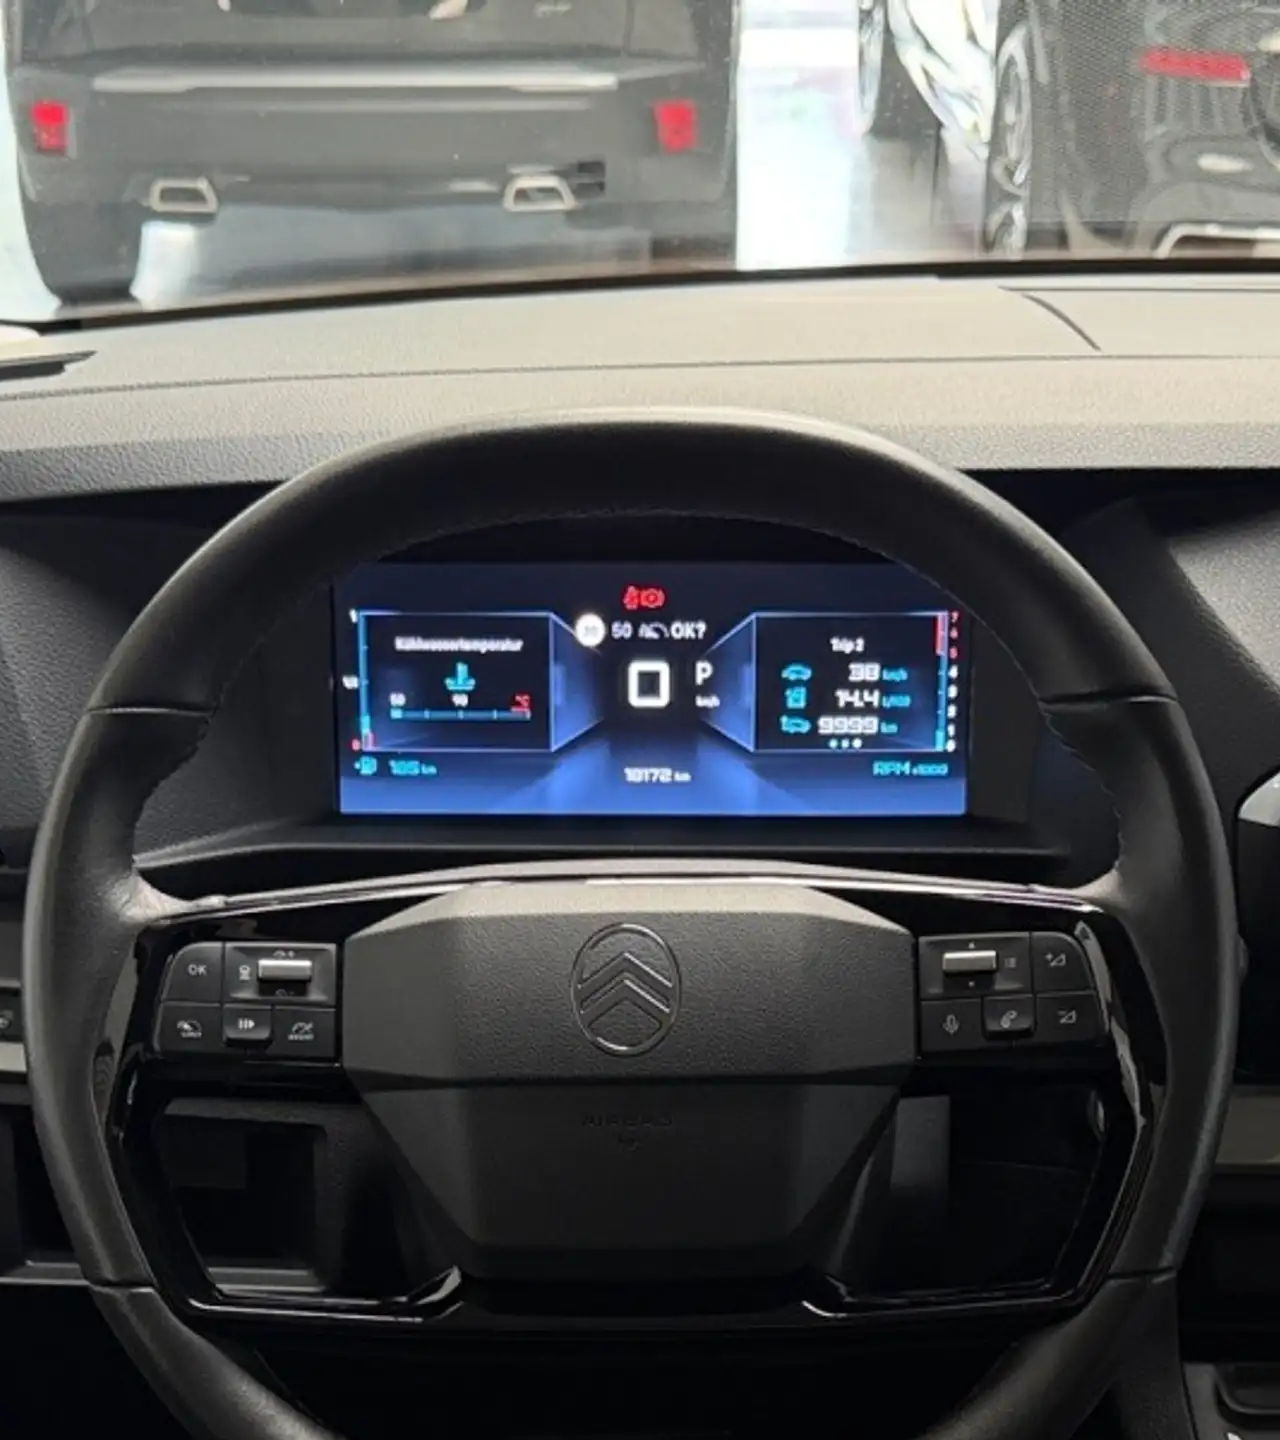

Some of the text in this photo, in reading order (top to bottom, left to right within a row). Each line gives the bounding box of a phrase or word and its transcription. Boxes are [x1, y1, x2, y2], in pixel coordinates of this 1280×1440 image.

[671, 621, 707, 639] OK?
[695, 660, 714, 686] P
[627, 660, 671, 708] 0
[873, 761, 911, 776] RPM
[187, 963, 207, 977] OK
